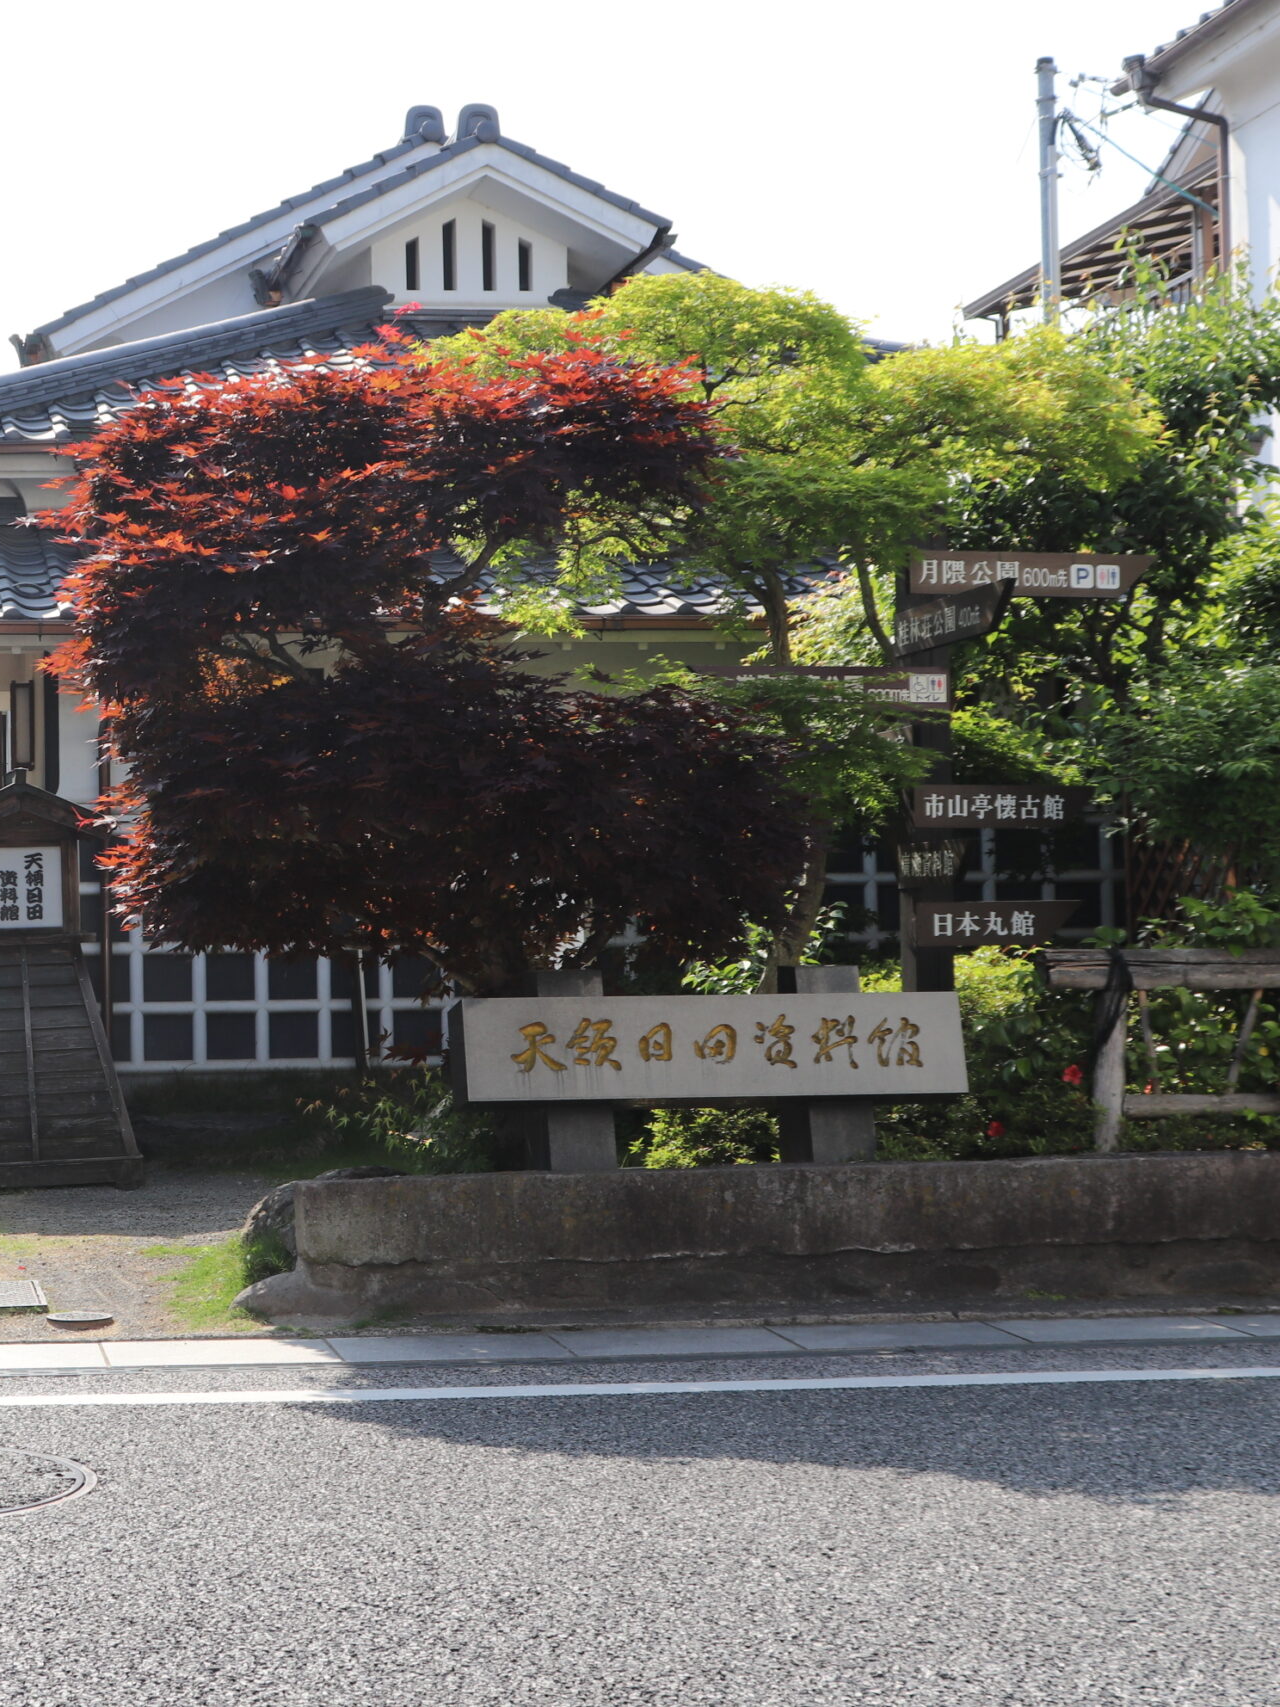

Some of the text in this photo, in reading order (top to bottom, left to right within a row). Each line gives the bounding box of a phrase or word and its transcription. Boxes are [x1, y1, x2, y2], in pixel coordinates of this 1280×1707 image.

[919, 559, 1020, 586] 月隈公園
[923, 793, 1066, 821] 市山亭懐古館
[0, 870, 20, 921] 資料館
[24, 852, 44, 921] 天領日田
[932, 911, 1036, 938] 日本丸館
[510, 1013, 924, 1073] 天領日田資料館
